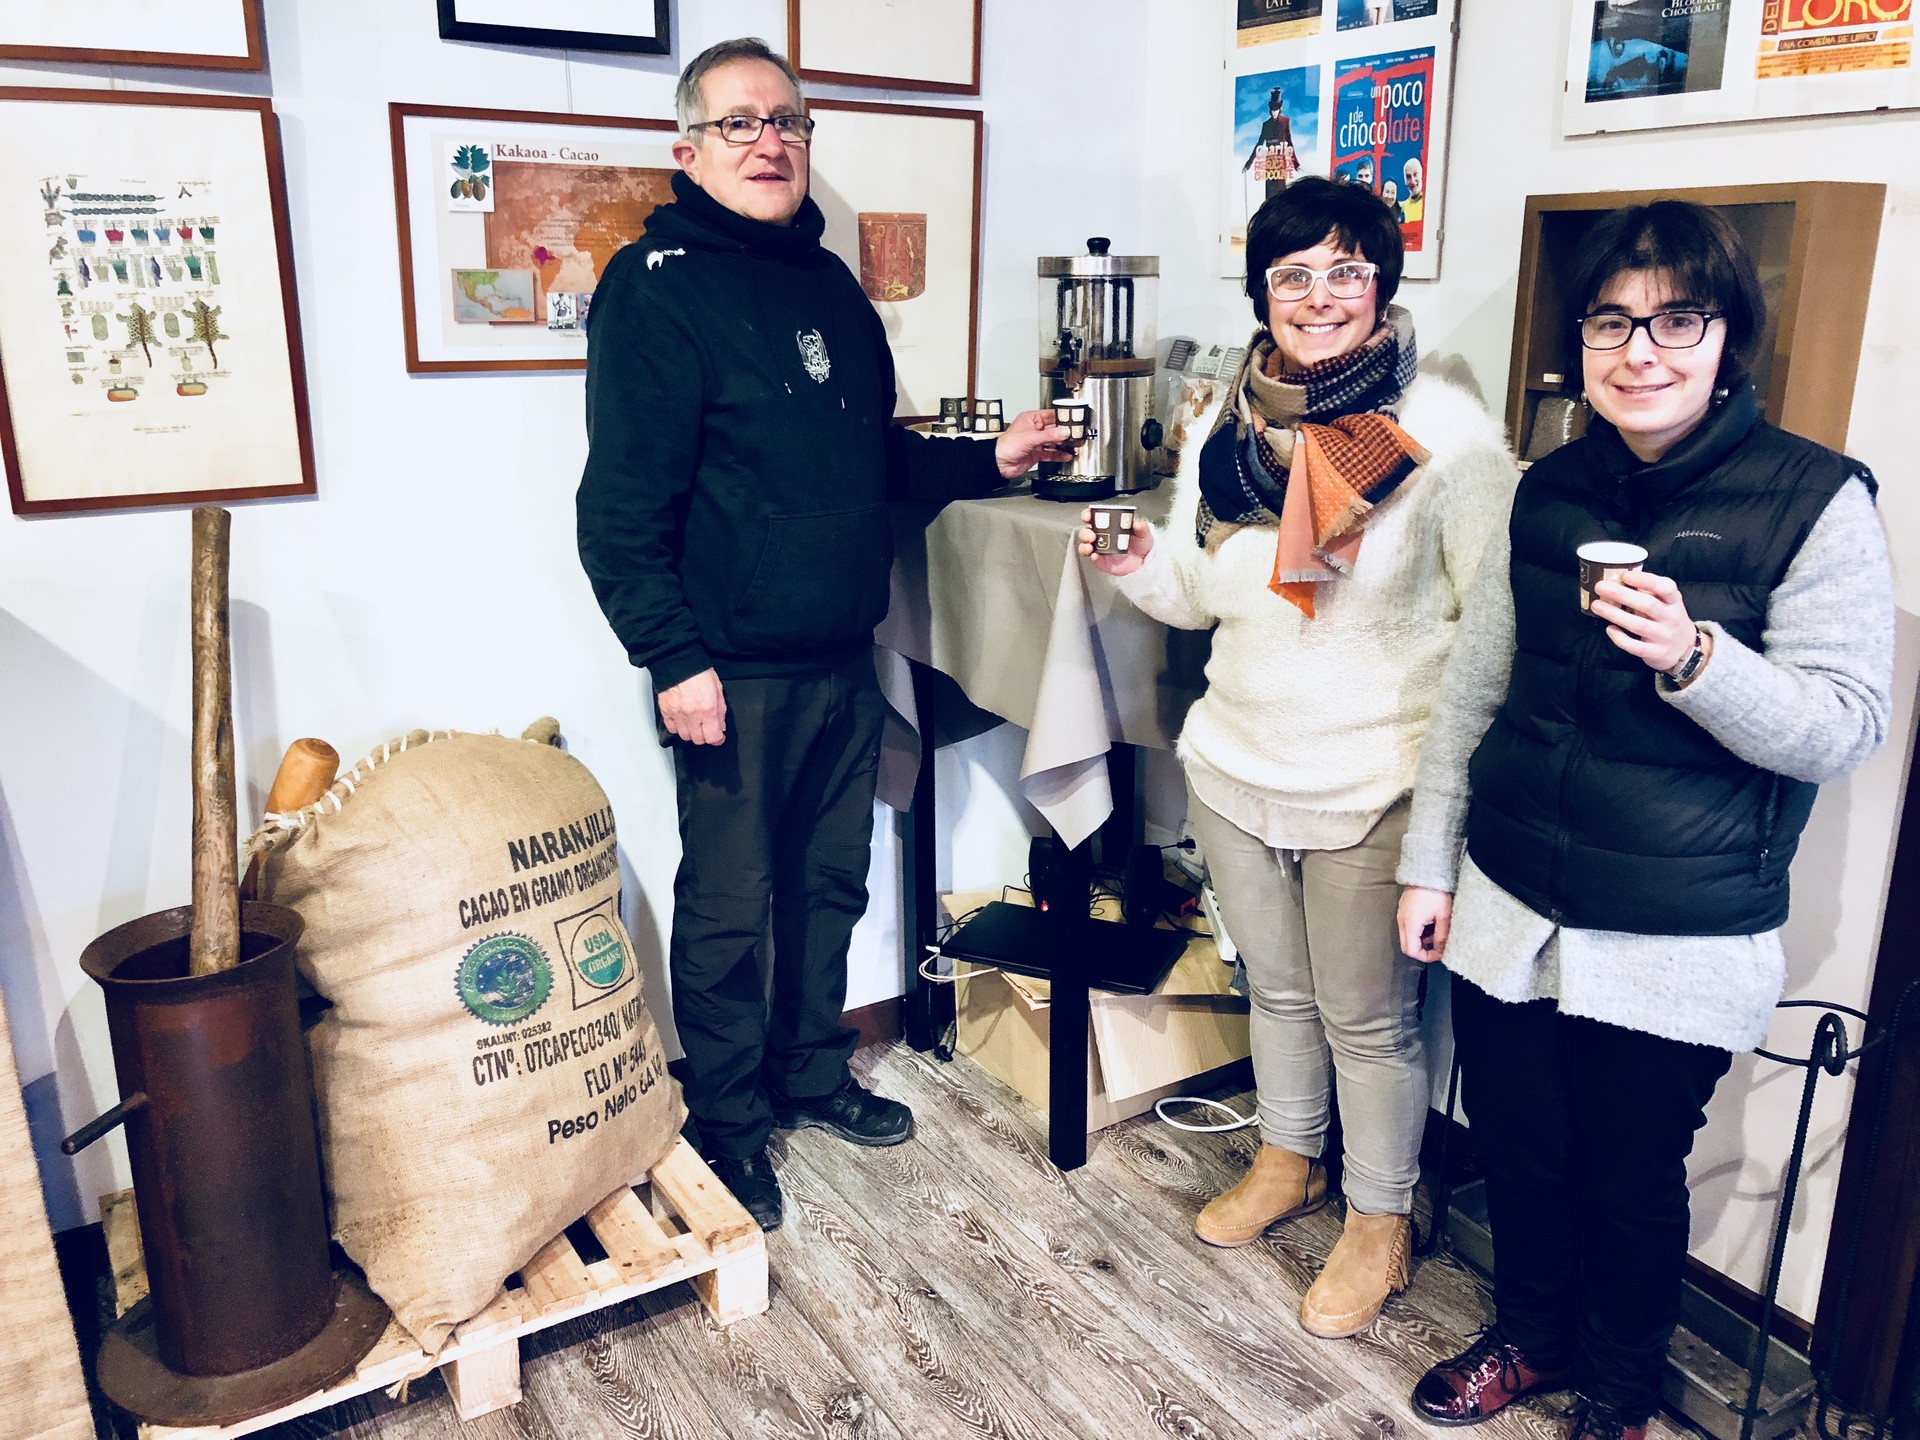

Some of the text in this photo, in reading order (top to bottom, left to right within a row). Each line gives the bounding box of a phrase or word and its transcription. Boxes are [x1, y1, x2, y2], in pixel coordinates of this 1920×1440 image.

[1662, 2, 1722, 18] CHOCOLATE
[1797, 37, 1835, 48] COMEDIA
[1353, 106, 1364, 123] de
[1371, 80, 1422, 117] un poco
[1340, 108, 1420, 148] chocolate
[496, 144, 548, 159] Kakaoa
[560, 147, 599, 161] Cacao
[508, 805, 616, 873] NARANJILLO
[459, 888, 509, 929] CACAO
[509, 881, 531, 913] EN
[532, 868, 574, 906] GRANO
[476, 1031, 521, 1050] SKALINT:
[584, 1062, 611, 1098] FLO
[548, 1111, 599, 1144] Peso
